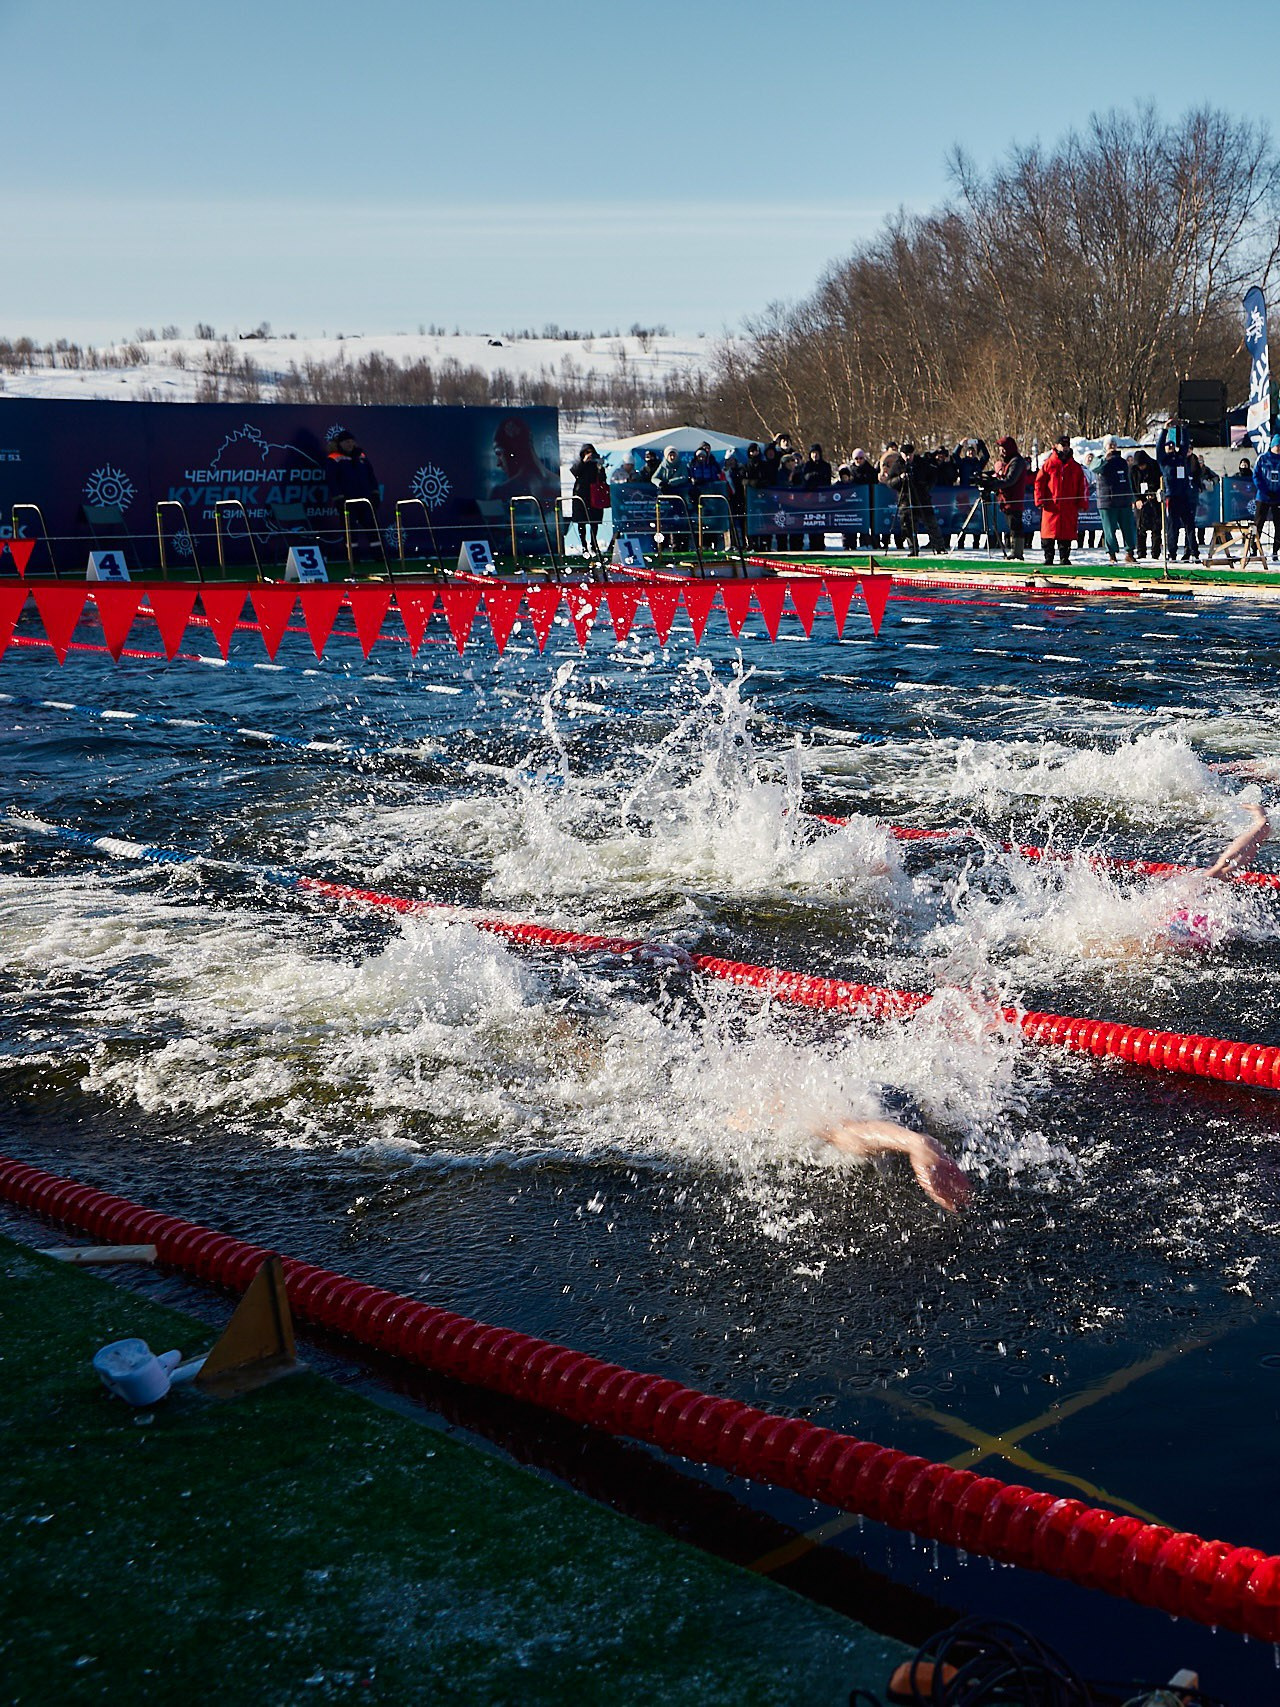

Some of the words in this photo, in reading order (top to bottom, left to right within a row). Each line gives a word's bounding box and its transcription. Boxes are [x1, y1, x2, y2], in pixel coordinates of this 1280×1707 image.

[185, 470, 287, 482] ЧЕМПИОНАТ
[168, 486, 259, 506] КУБОК
[222, 509, 272, 519] ЗИМНЕМ
[297, 549, 319, 569] 3
[469, 543, 488, 563] 2
[623, 541, 638, 560] 1
[99, 553, 122, 576] 4
